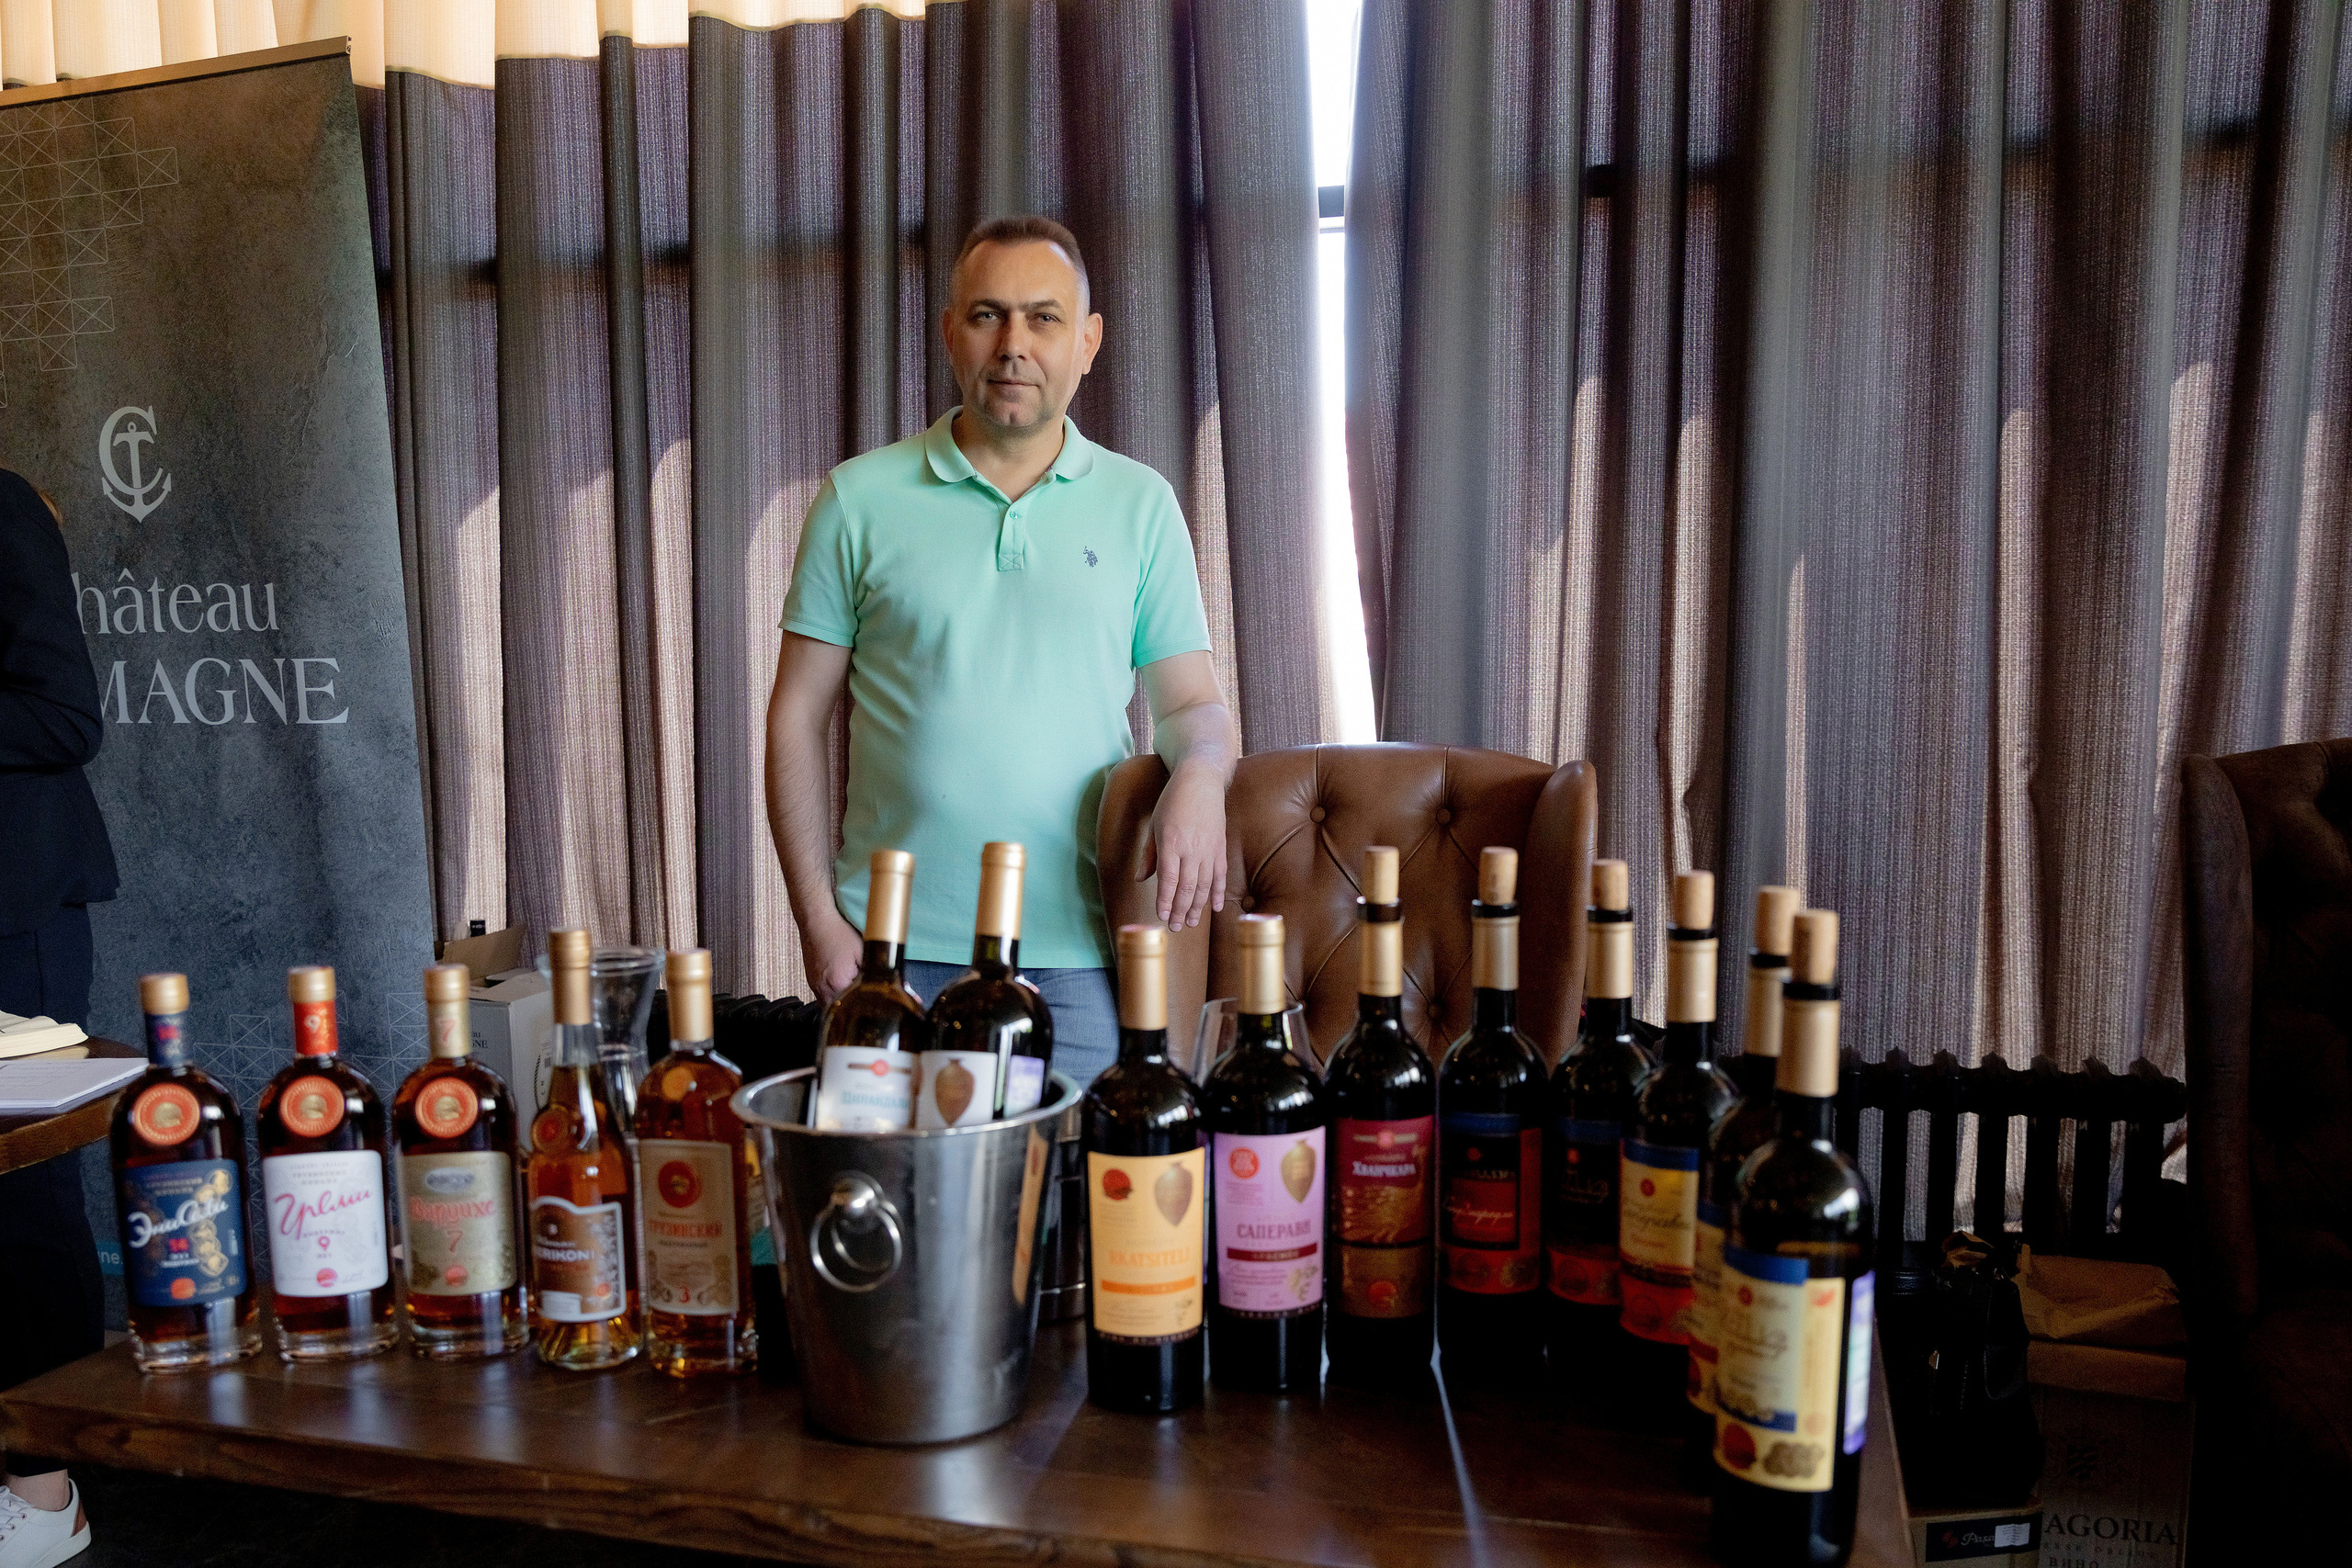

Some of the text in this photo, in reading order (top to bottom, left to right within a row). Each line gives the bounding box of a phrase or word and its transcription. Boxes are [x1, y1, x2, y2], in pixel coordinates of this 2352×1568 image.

[72, 569, 279, 635] hâteau
[99, 657, 349, 726] MAGNE
[2045, 1514, 2176, 1545] AGORIA
